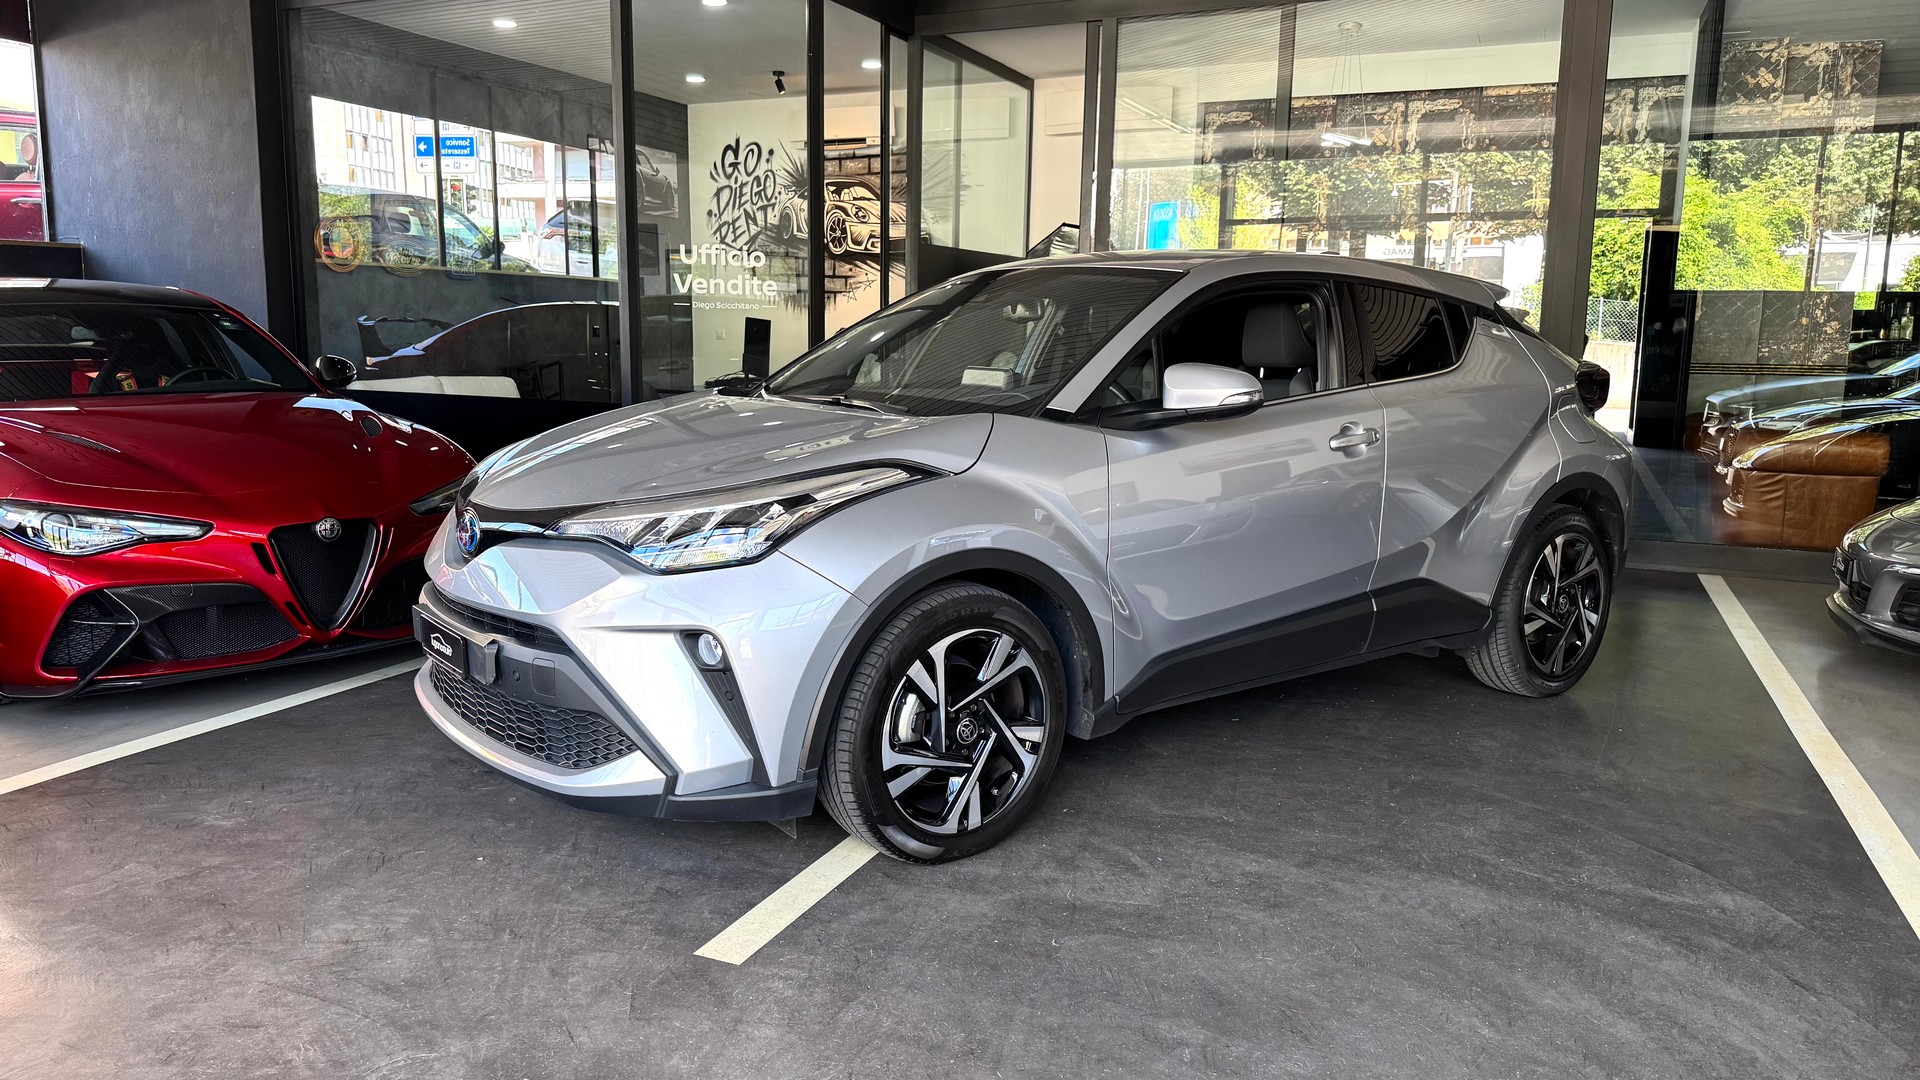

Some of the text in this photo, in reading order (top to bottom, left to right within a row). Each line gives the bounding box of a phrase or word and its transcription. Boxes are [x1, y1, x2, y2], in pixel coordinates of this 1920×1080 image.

[721, 136, 762, 180] GO
[711, 202, 776, 251] RENT
[680, 243, 766, 268] Ufficio
[673, 272, 778, 296] Vendite
[692, 301, 760, 310] Diego Scicchitano
